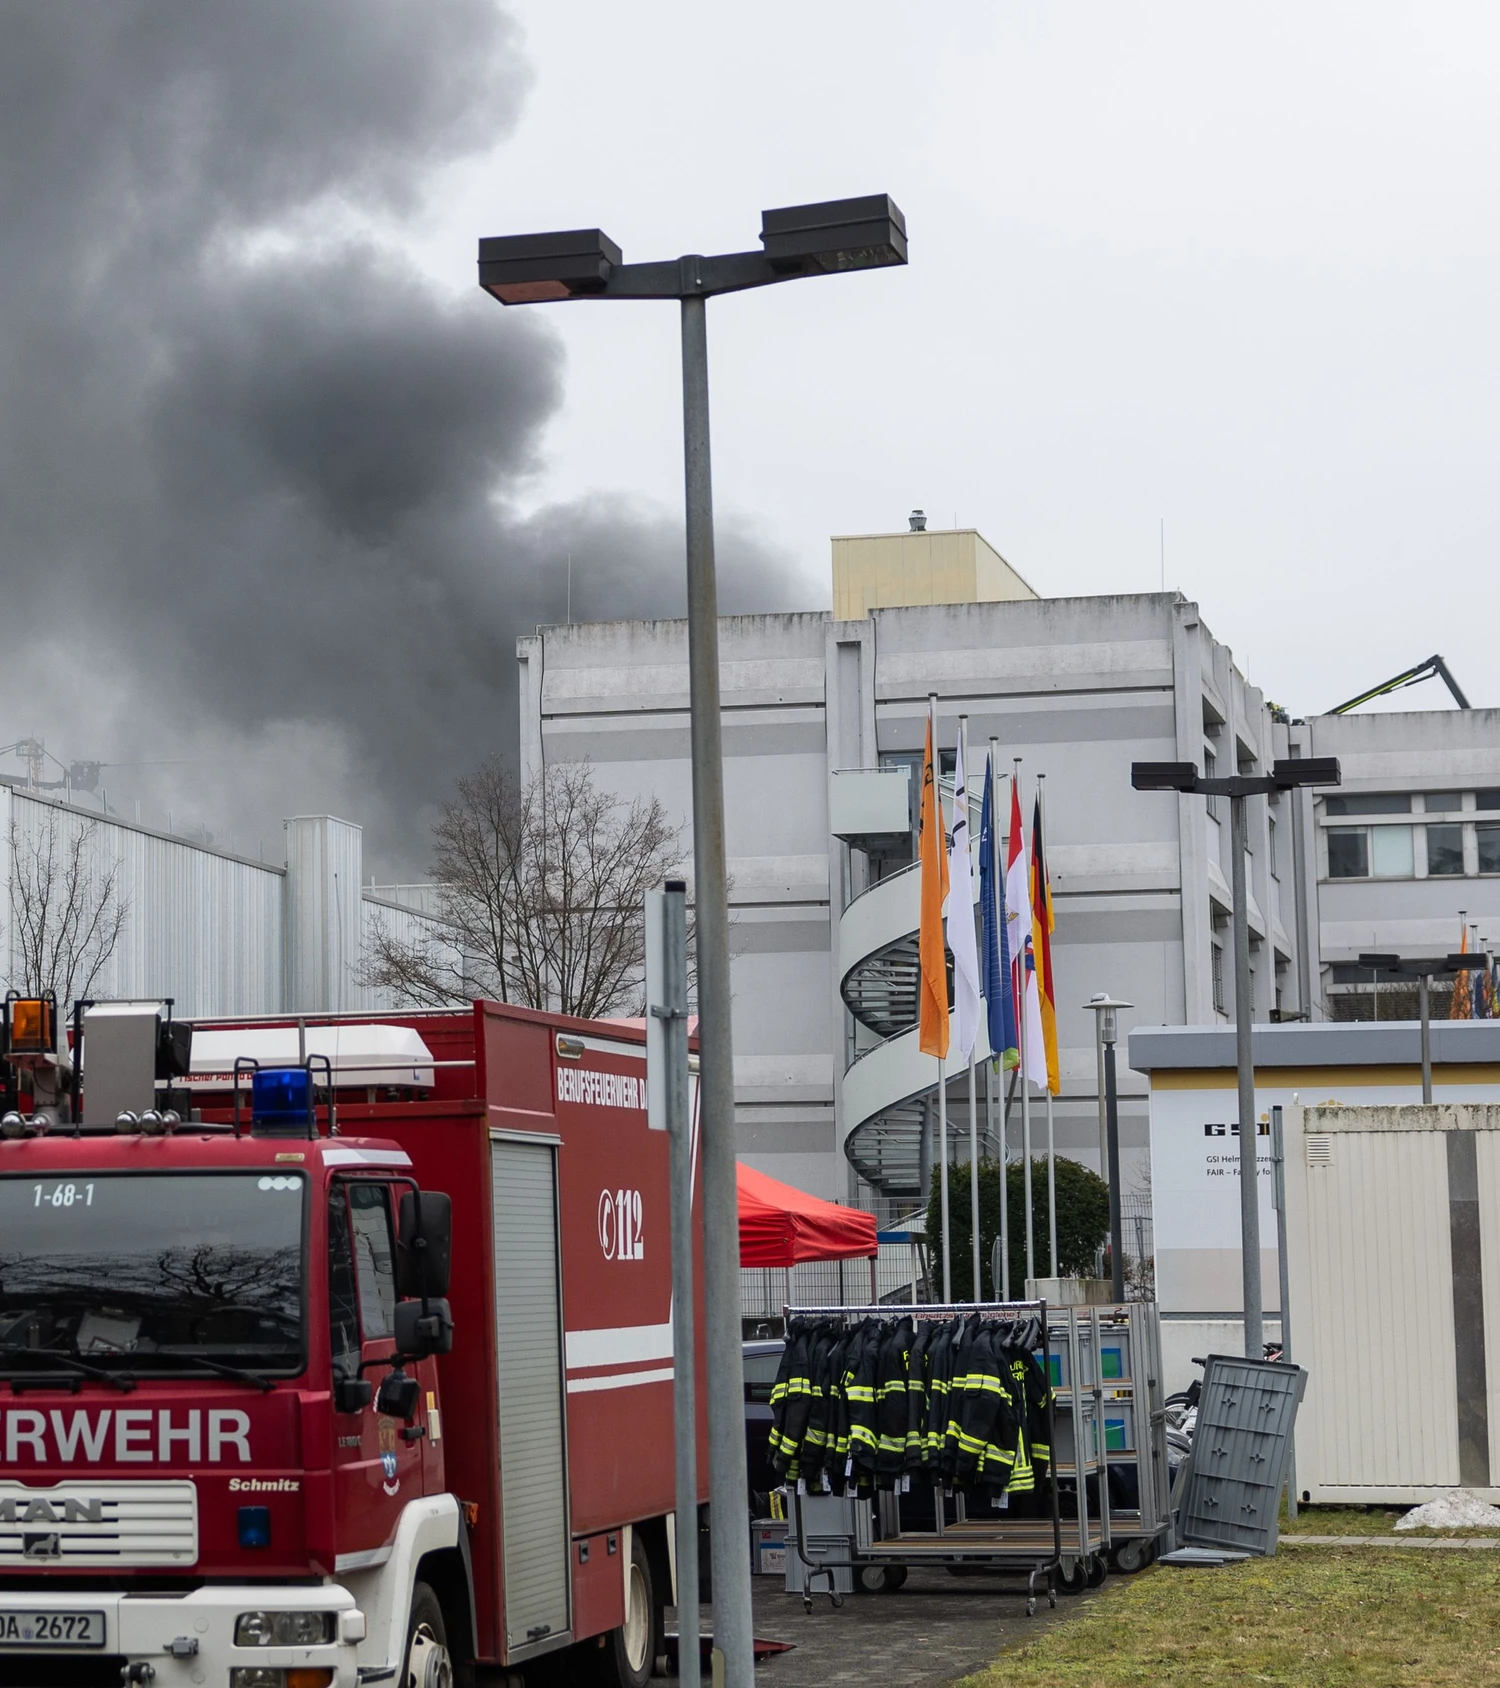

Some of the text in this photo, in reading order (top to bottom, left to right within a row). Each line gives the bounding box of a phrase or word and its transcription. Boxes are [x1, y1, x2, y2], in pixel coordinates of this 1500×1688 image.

[557, 1067, 639, 1110] BERUFSFEUERWEHR
[1206, 1155, 1220, 1163] GSI
[1206, 1168, 1225, 1176] FAIR
[34, 1183, 95, 1208] 1-68-1
[615, 1189, 644, 1260] 112
[228, 1477, 300, 1492] Schmitz
[35, 1615, 91, 1640] 2672
